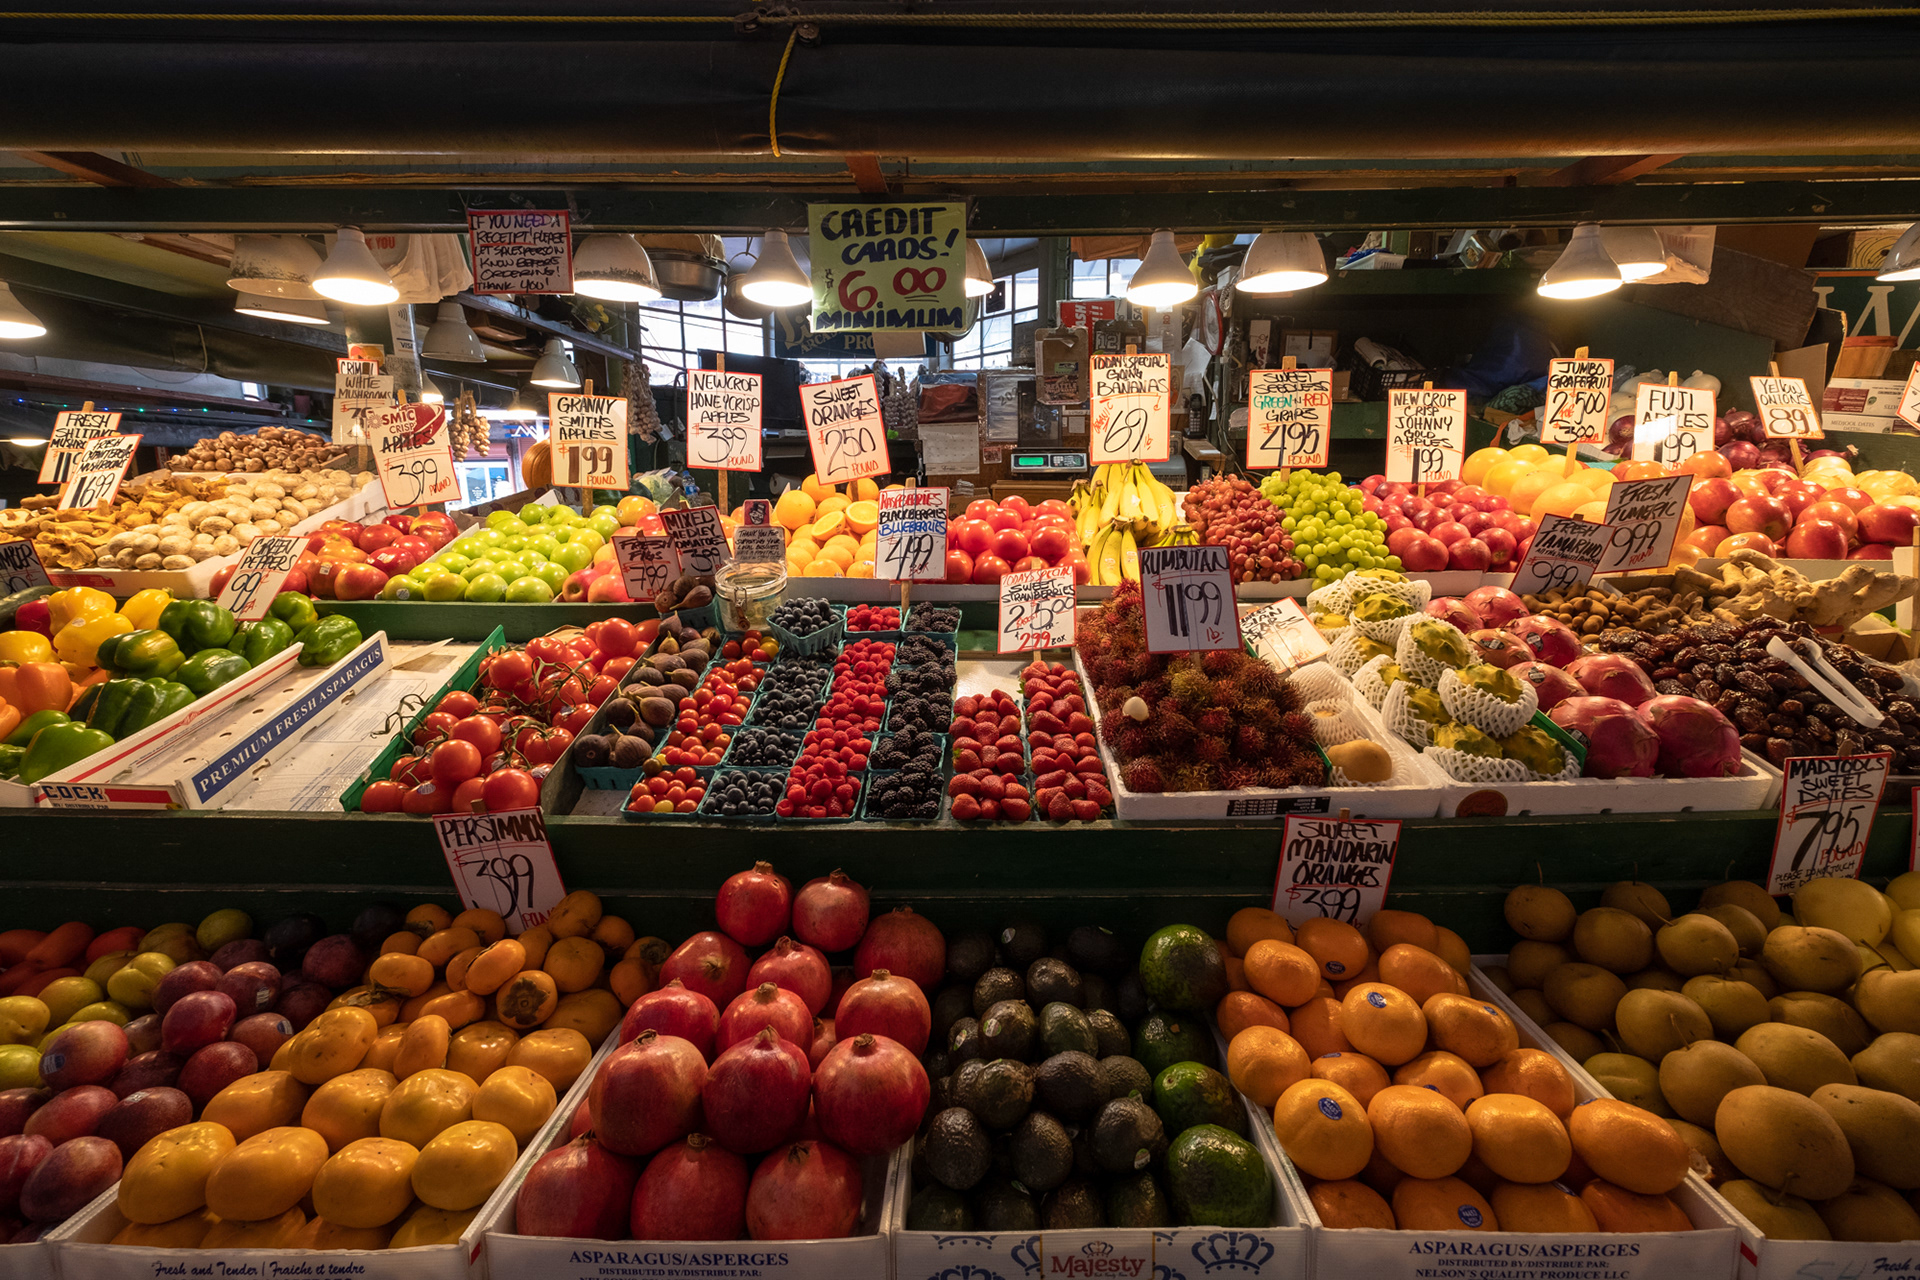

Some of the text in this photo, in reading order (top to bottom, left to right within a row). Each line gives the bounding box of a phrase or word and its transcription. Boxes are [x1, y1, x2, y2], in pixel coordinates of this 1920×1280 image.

[469, 214, 486, 231] IF
[489, 214, 512, 229] YOU
[514, 213, 553, 229] NEED
[820, 207, 947, 241] CREDIT
[841, 228, 960, 266] CARDS!
[480, 257, 515, 269] KNOW
[476, 281, 516, 291] THANK
[1262, 371, 1317, 383] SWEET
[1556, 361, 1606, 376] JUMBO
[345, 376, 381, 389] WHITE
[1097, 378, 1169, 396] BANANAS
[690, 392, 761, 413] HONEYCRISP
[813, 383, 863, 405] SWEET
[1253, 392, 1331, 410] GREEN RED
[1393, 392, 1457, 408] NEW CROP
[1649, 389, 1693, 412] FUJI
[1759, 394, 1811, 407] ONIONS
[557, 396, 618, 415] GRANNY
[811, 398, 878, 426] ORANGES
[1403, 406, 1440, 417] CRISP
[66, 413, 112, 428] FRESH
[700, 410, 751, 424] APPLES
[1394, 415, 1453, 432] JOHNNY
[1642, 411, 1709, 429] AES
[389, 421, 416, 434] CRISP
[559, 427, 617, 441] APPLES
[1103, 407, 1148, 453] 69
[1403, 429, 1436, 439] GOLD
[379, 429, 436, 454] APPLES
[1393, 435, 1454, 449] APPLES
[727, 453, 755, 467] POUND
[851, 459, 879, 476] POUND
[1287, 453, 1322, 465] POUND
[586, 475, 617, 486] POUND
[1425, 469, 1452, 481] POUND
[1618, 476, 1681, 504] FRESH
[664, 510, 716, 530] MIXED
[879, 508, 947, 525] BLACKBERRIES
[1607, 500, 1678, 525] TUMERIC
[878, 519, 947, 536] BLUEBERRIES
[1552, 518, 1601, 537] FRESH
[250, 537, 300, 556] GREEN
[618, 537, 673, 551] FRESH
[675, 535, 727, 549] OMATOES
[240, 554, 298, 572] PEPPERS
[1141, 548, 1230, 575] RUMBUTAN
[1627, 545, 1656, 566] POUND
[1001, 583, 1076, 604] STRAWBERRIES
[1051, 634, 1067, 646] BOX
[199, 731, 274, 793] PREMIUM
[275, 697, 318, 736] FRESH
[319, 648, 382, 704] ASPARAGUS
[1801, 771, 1867, 791] SWEET
[42, 785, 104, 800] COCK
[1797, 783, 1875, 805] DATES
[1297, 822, 1384, 840] SWEET
[1286, 839, 1397, 864] MANDARIN
[1292, 861, 1381, 888] ORANGES
[1779, 881, 1796, 891] THE
[1408, 1241, 1641, 1257] ASPARAGUS/ASPERGES
[568, 1250, 789, 1266] ASPARAGUS/ASPERGES
[1050, 1255, 1146, 1278] Majesty
[1437, 1258, 1509, 1268] DISTRIBUTED
[1585, 1259, 1610, 1269] PAR:
[1872, 1257, 1913, 1275] Fresh
[152, 1261, 366, 1277] Fresh and Tender Fraiche et tendre
[599, 1267, 666, 1277] DISTRIBUTED
[738, 1269, 763, 1278] PAR:
[1479, 1269, 1539, 1280] QUALITY
[1539, 1269, 1602, 1280] PRODUCE
[1604, 1270, 1631, 1280] LLC
